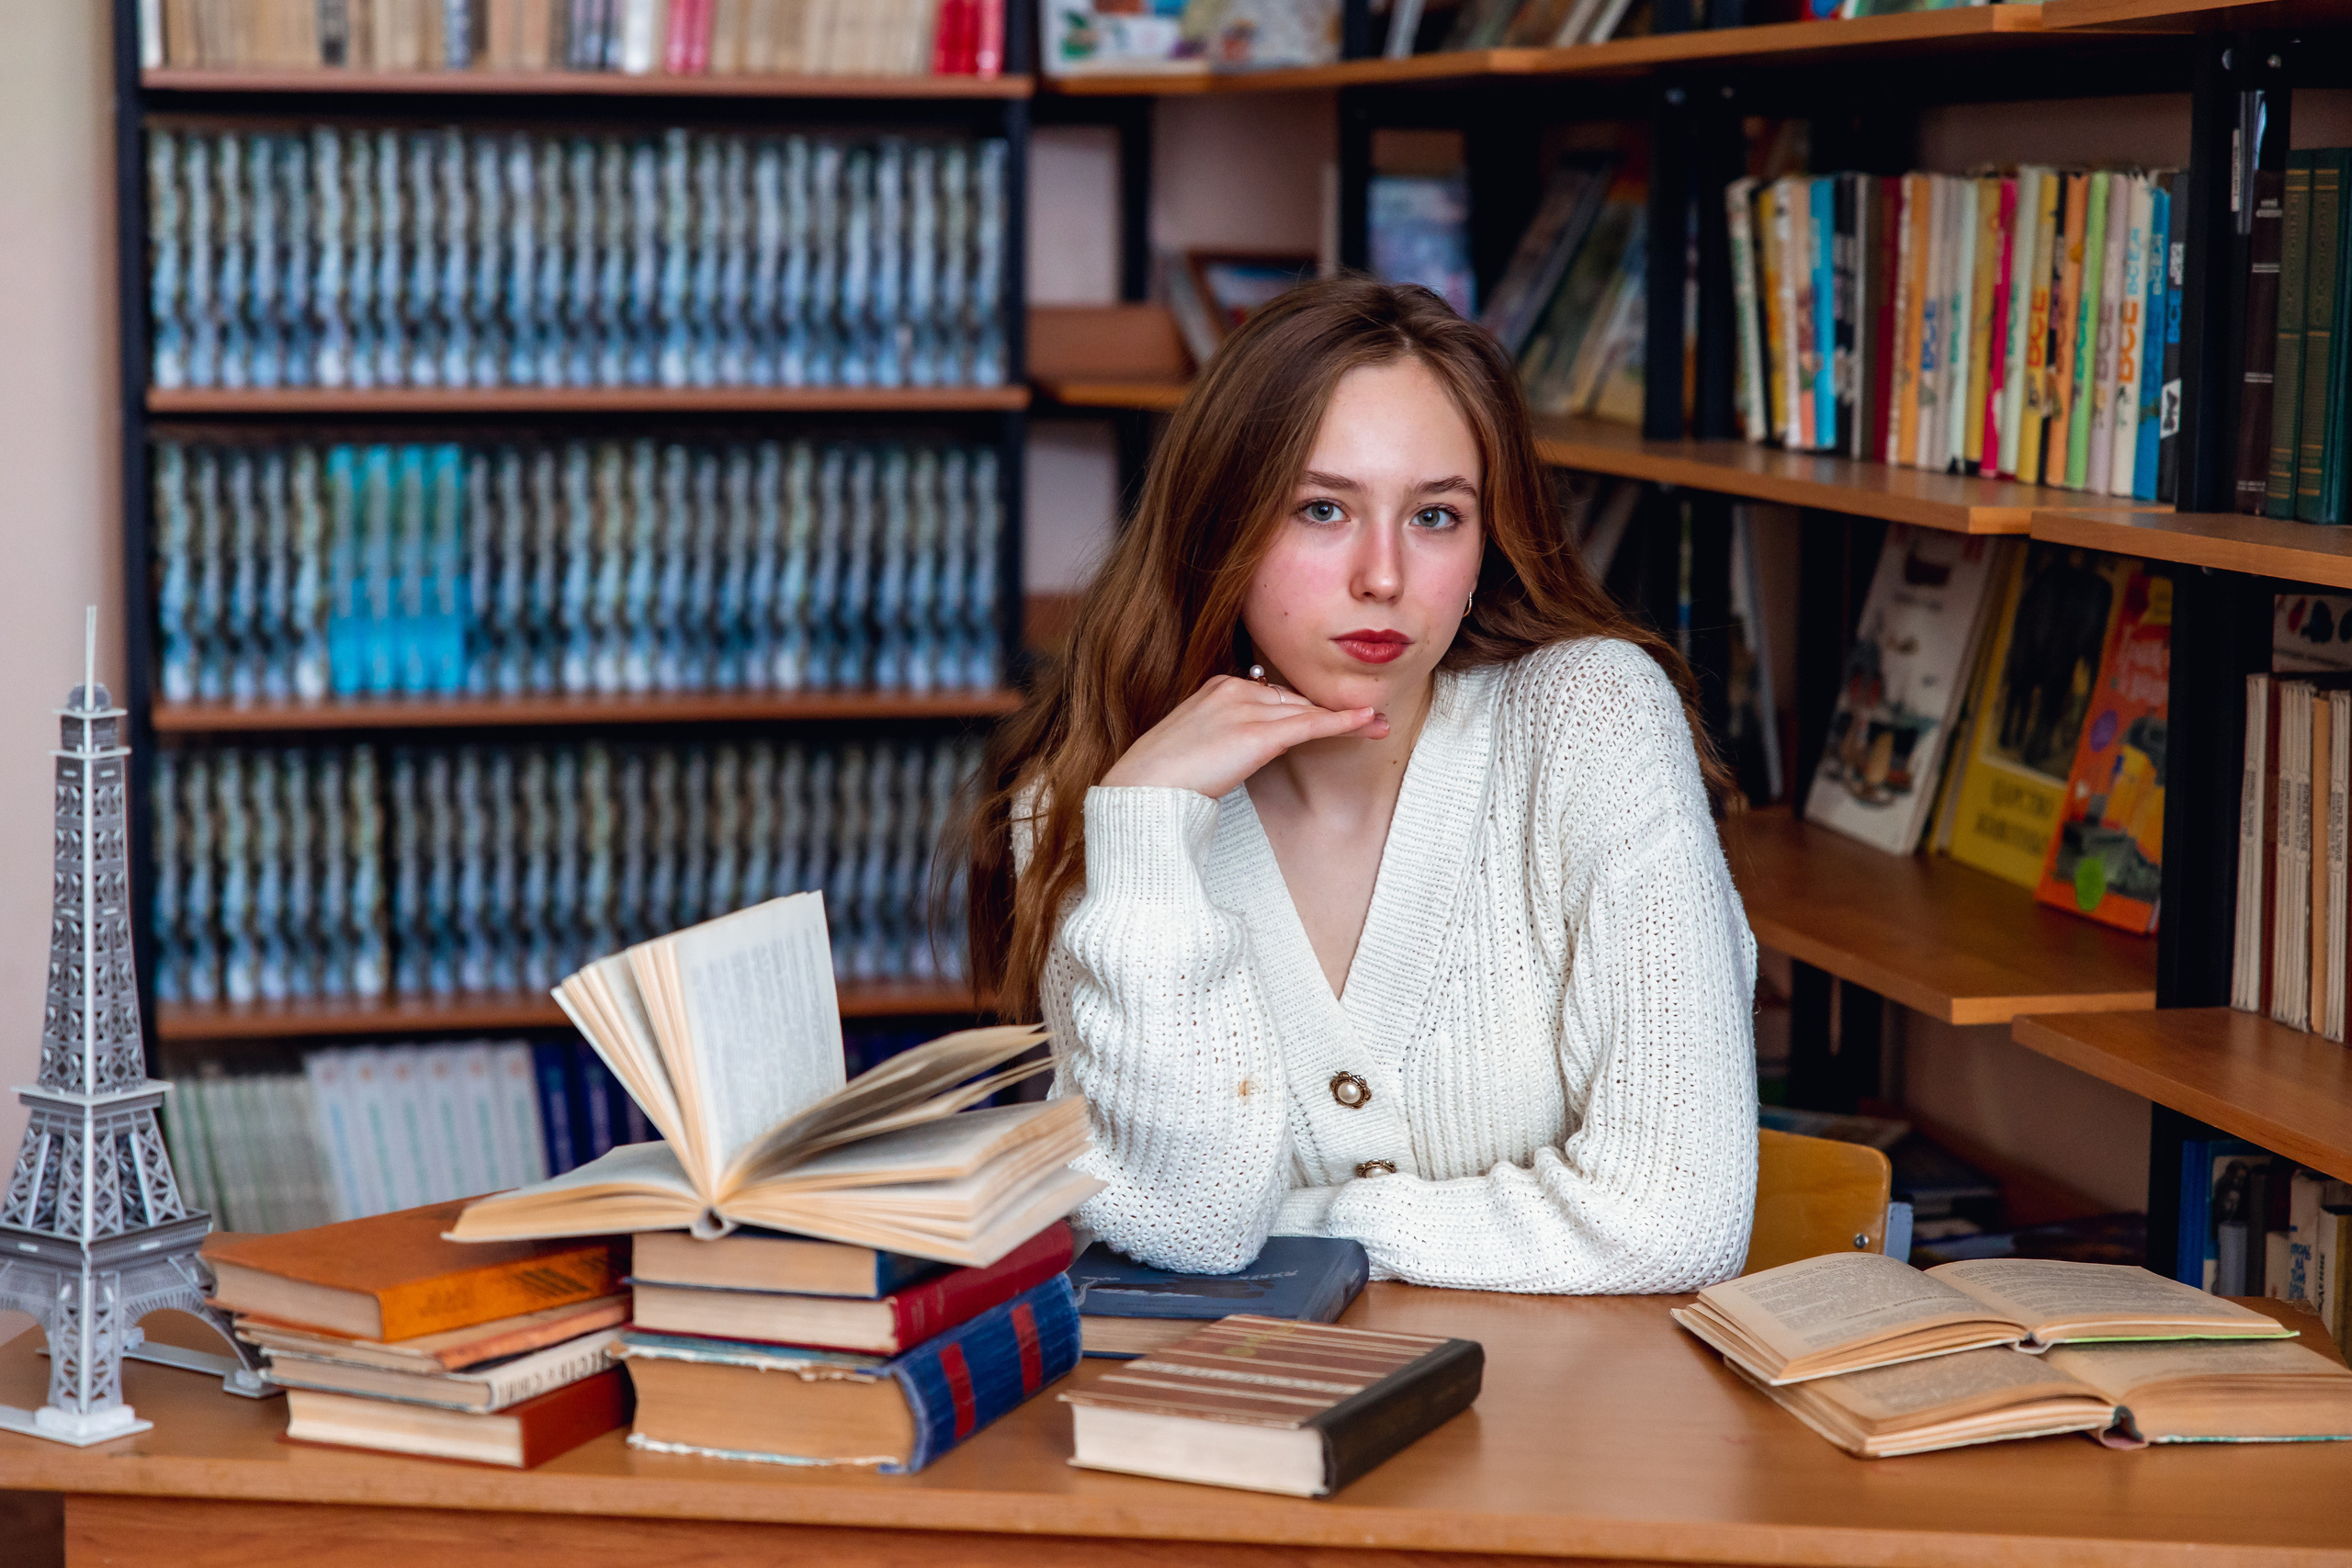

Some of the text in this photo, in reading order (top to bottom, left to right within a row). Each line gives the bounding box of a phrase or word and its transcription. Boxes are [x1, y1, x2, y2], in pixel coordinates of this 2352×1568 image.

[2026, 290, 2047, 368] ВСЕ
[2117, 301, 2139, 384] ВСЕ
[2166, 288, 2183, 344] ВСЕ
